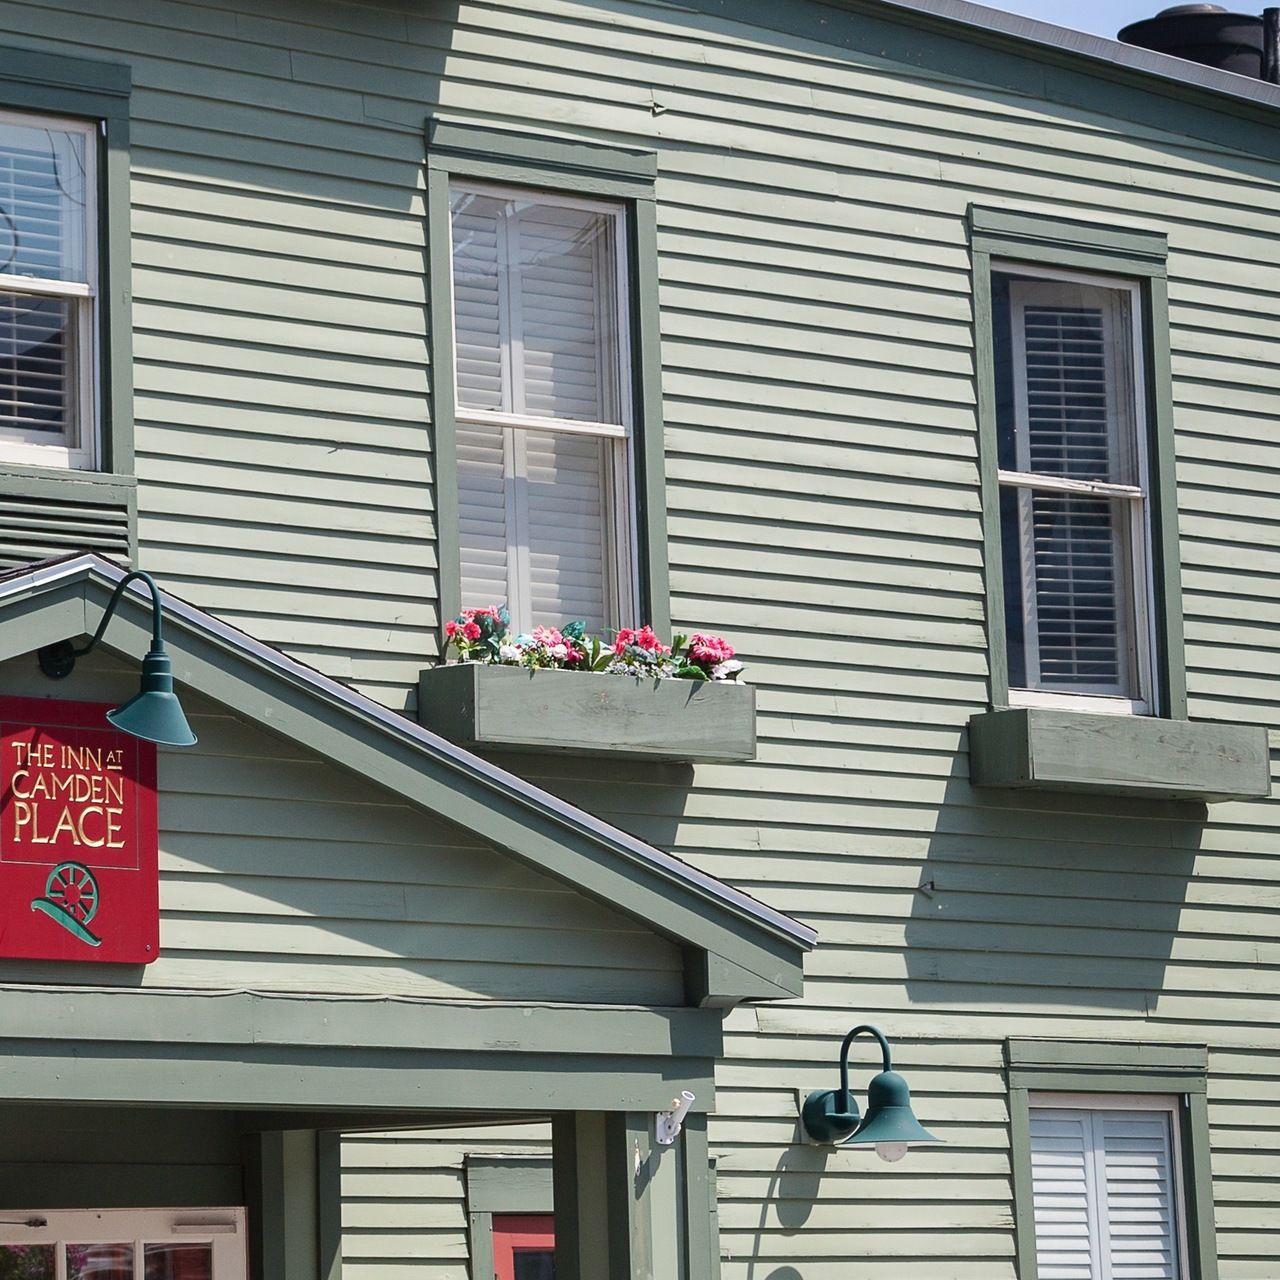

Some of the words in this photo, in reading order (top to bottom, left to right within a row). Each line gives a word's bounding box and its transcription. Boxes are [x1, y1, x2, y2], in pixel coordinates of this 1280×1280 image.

[11, 741, 56, 768] THE
[61, 745, 102, 772] INN
[106, 749, 124, 765] AT
[11, 769, 124, 805] CAMDEN
[13, 801, 126, 848] PLACE
